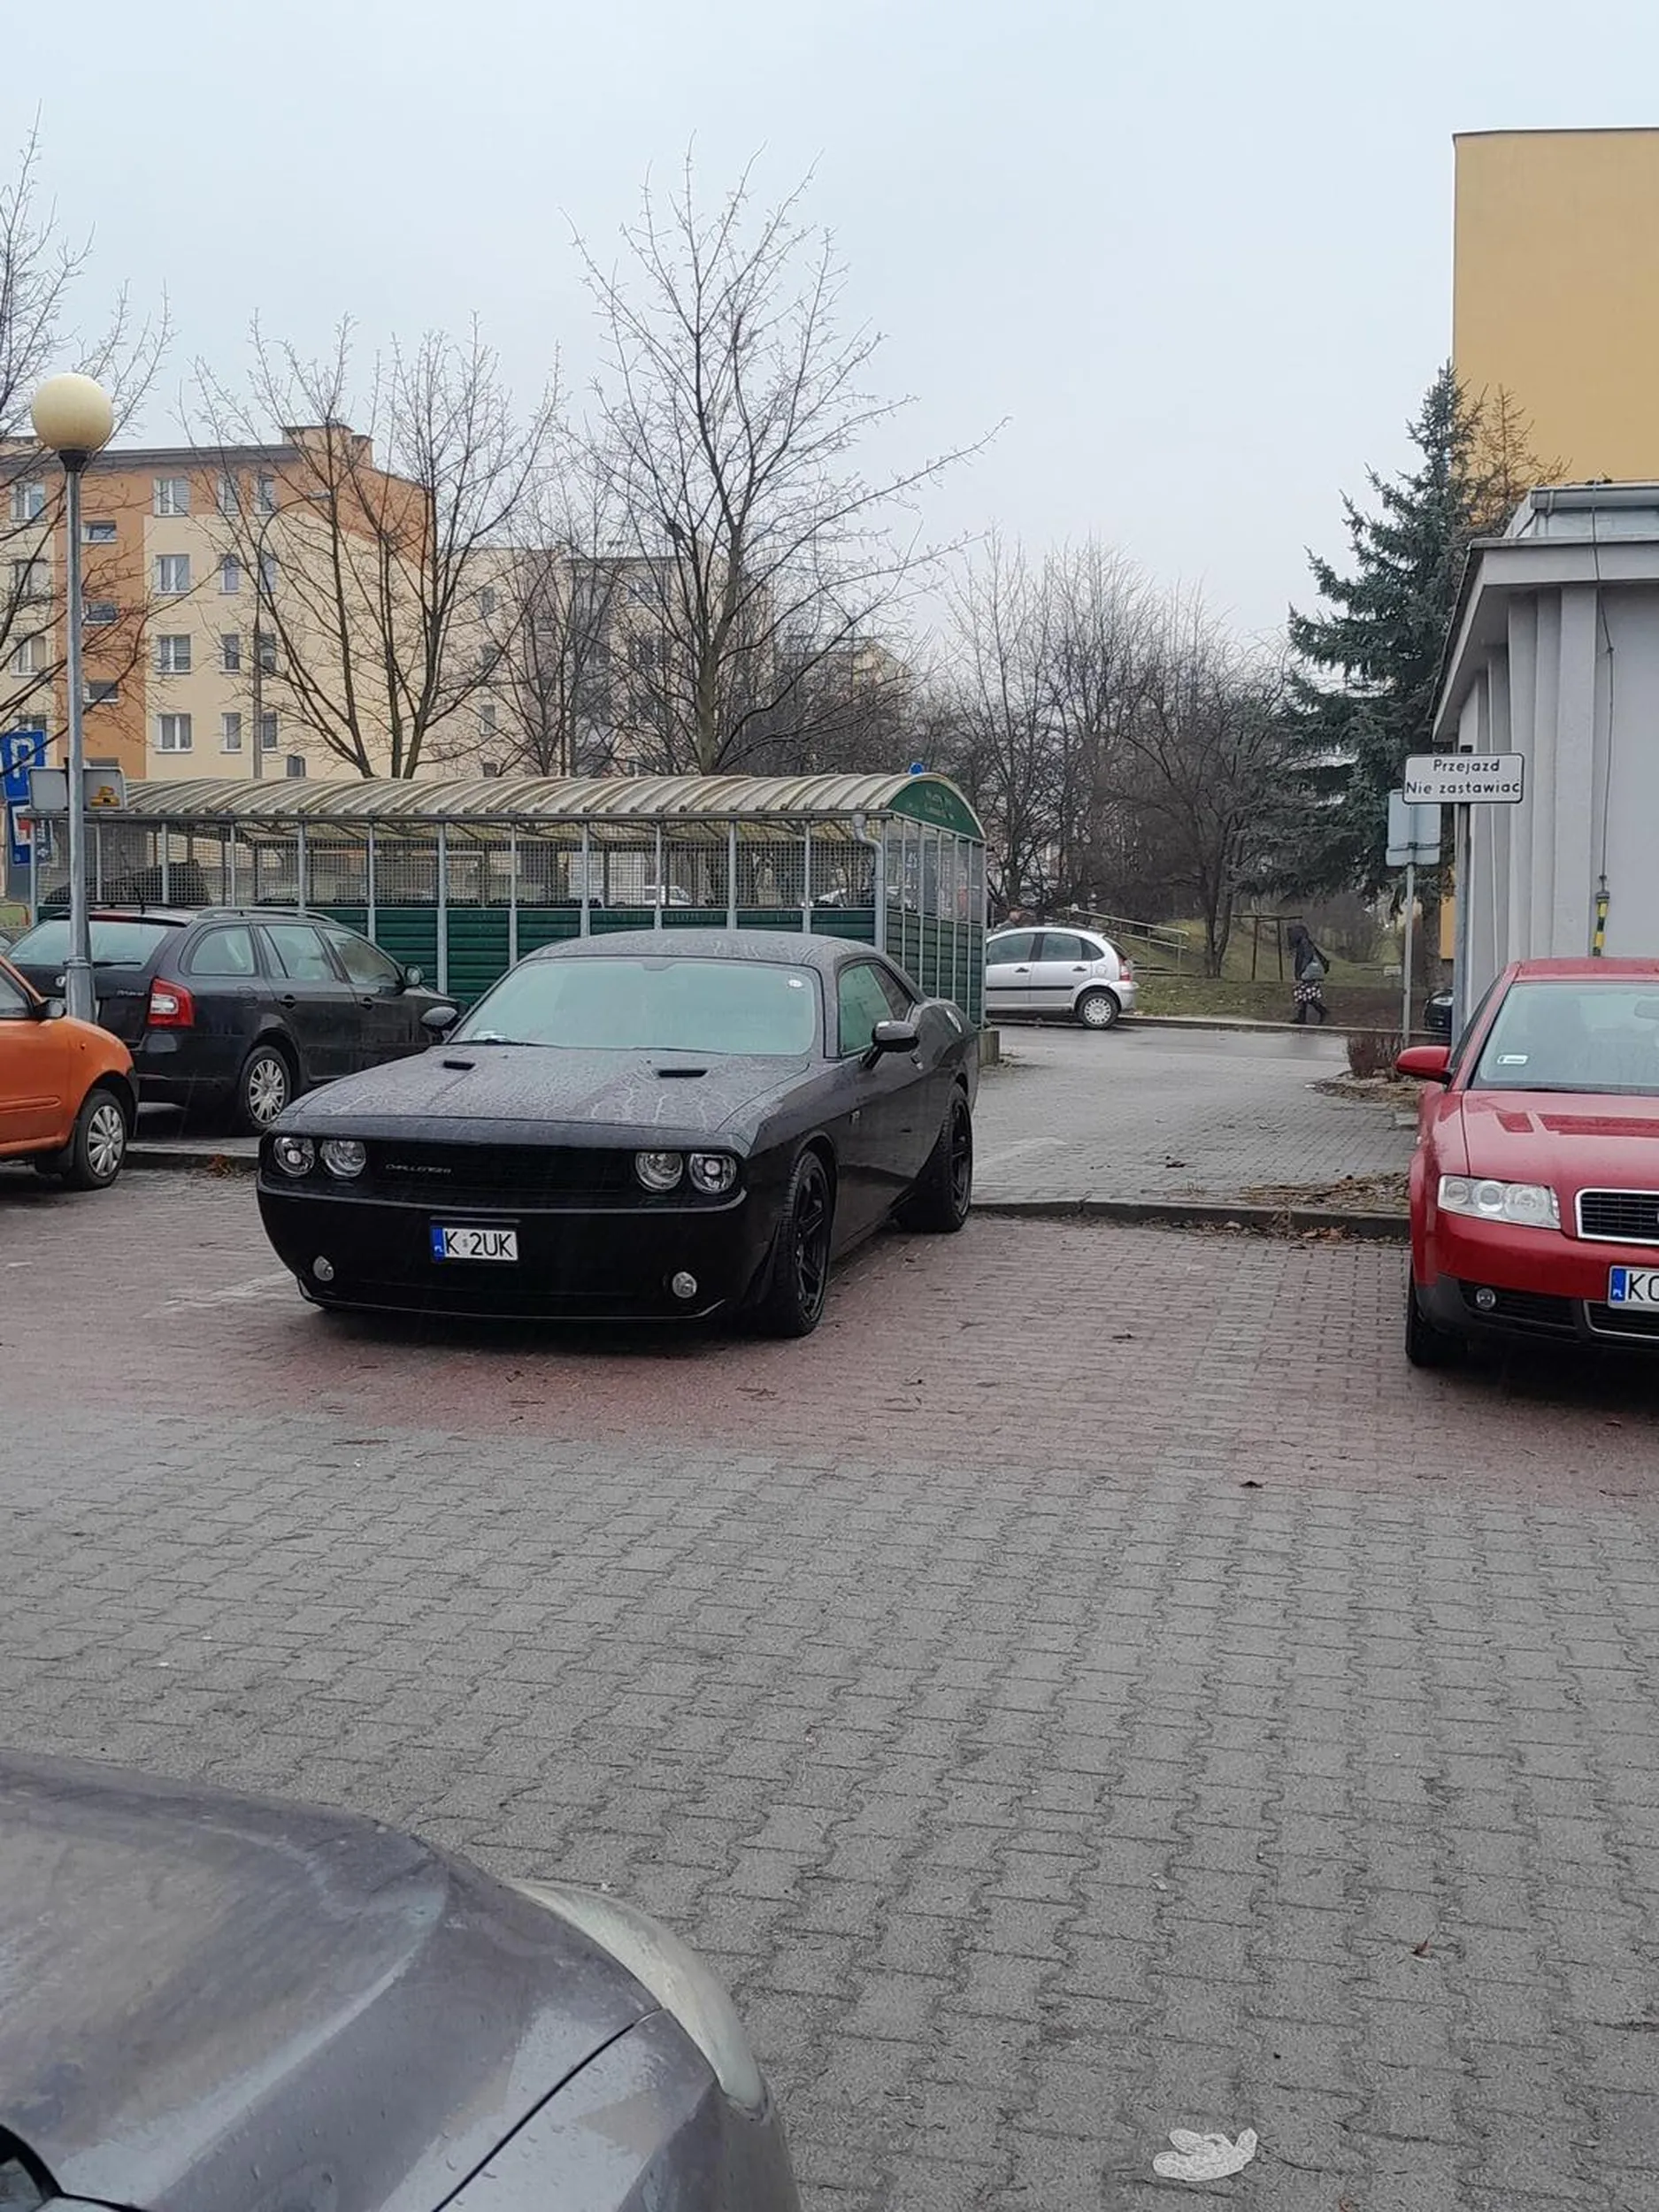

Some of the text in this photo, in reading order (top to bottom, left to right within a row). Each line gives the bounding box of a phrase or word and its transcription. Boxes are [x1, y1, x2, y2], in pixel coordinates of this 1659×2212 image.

[10, 737, 36, 779] P
[1433, 758, 1500, 774] Przejazd
[1406, 780, 1520, 794] Nie zastawiać
[445, 1231, 514, 1257] K 2UK
